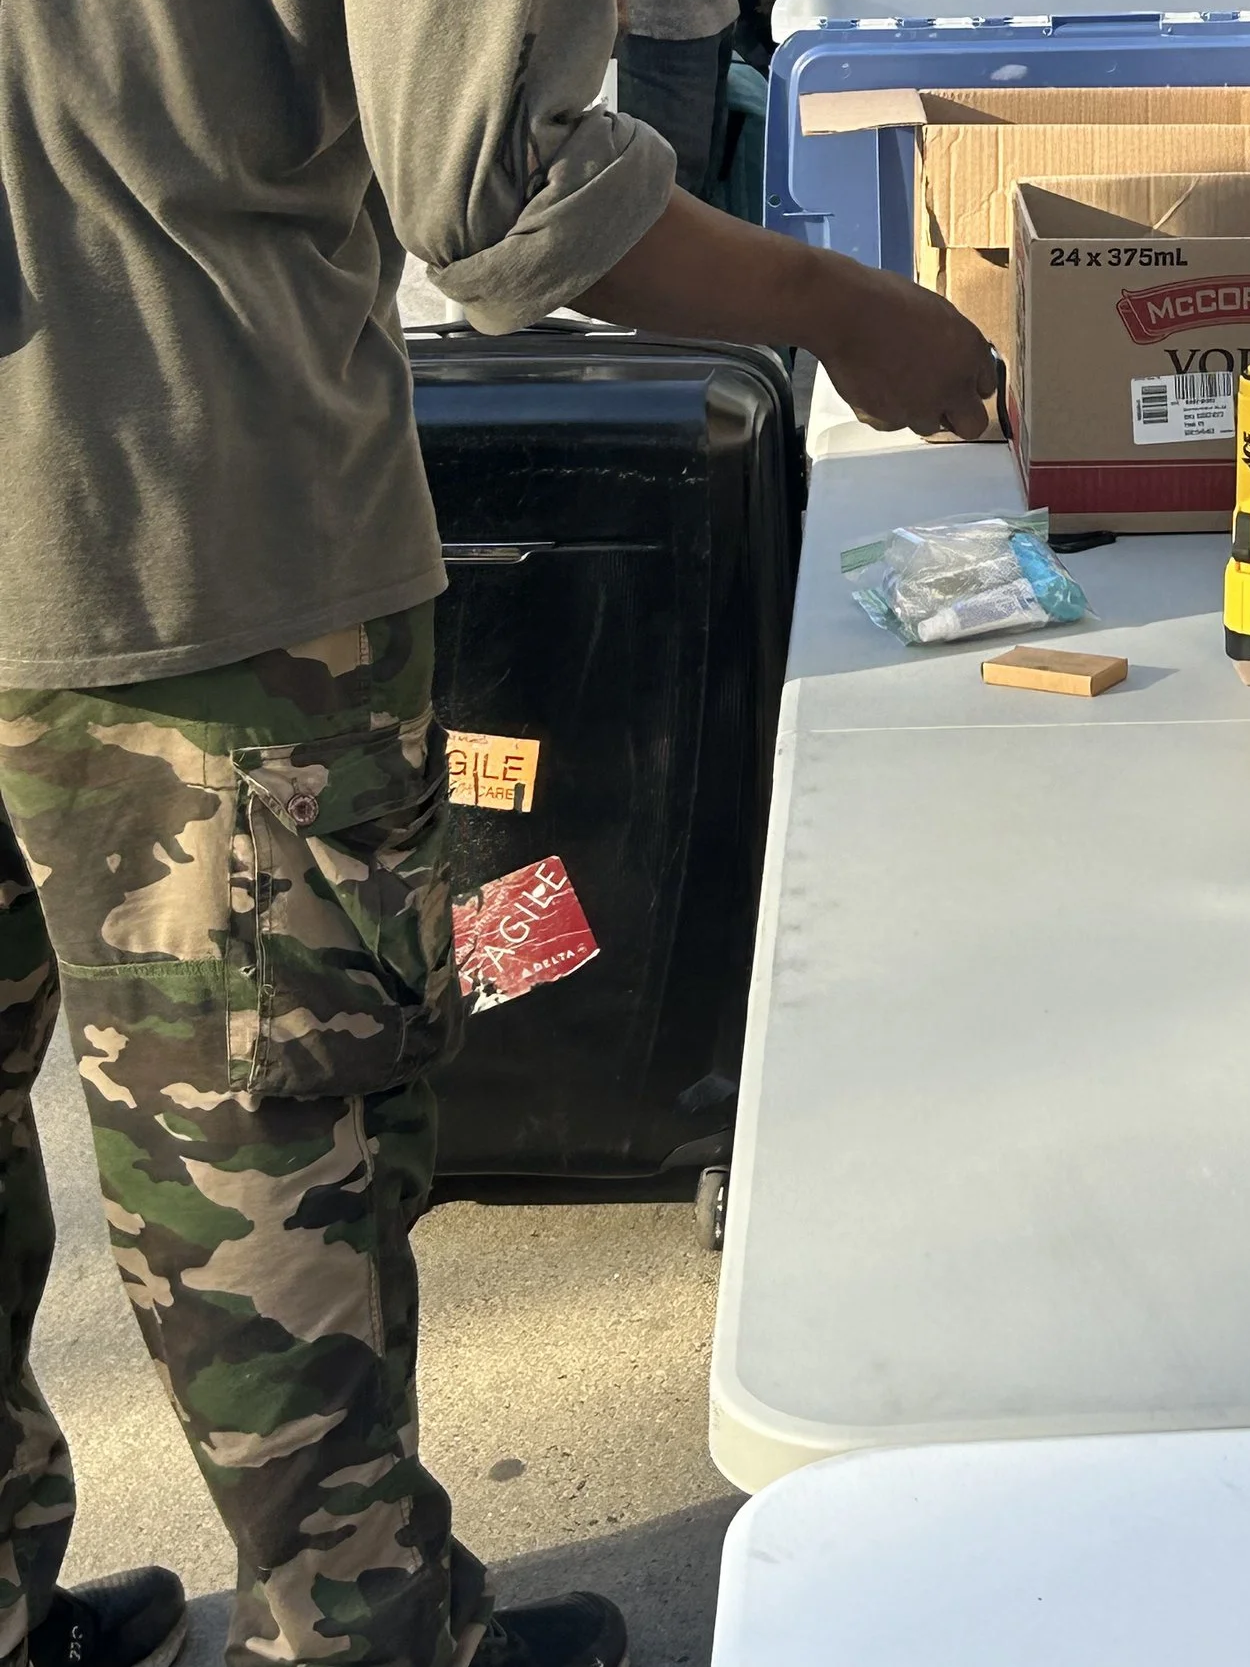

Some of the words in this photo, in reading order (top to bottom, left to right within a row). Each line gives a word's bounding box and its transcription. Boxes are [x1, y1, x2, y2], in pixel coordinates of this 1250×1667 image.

[1050, 248, 1081, 266] 24
[1086, 252, 1102, 266] x
[1107, 248, 1188, 266] 375mL
[532, 949, 576, 973] DELTA
